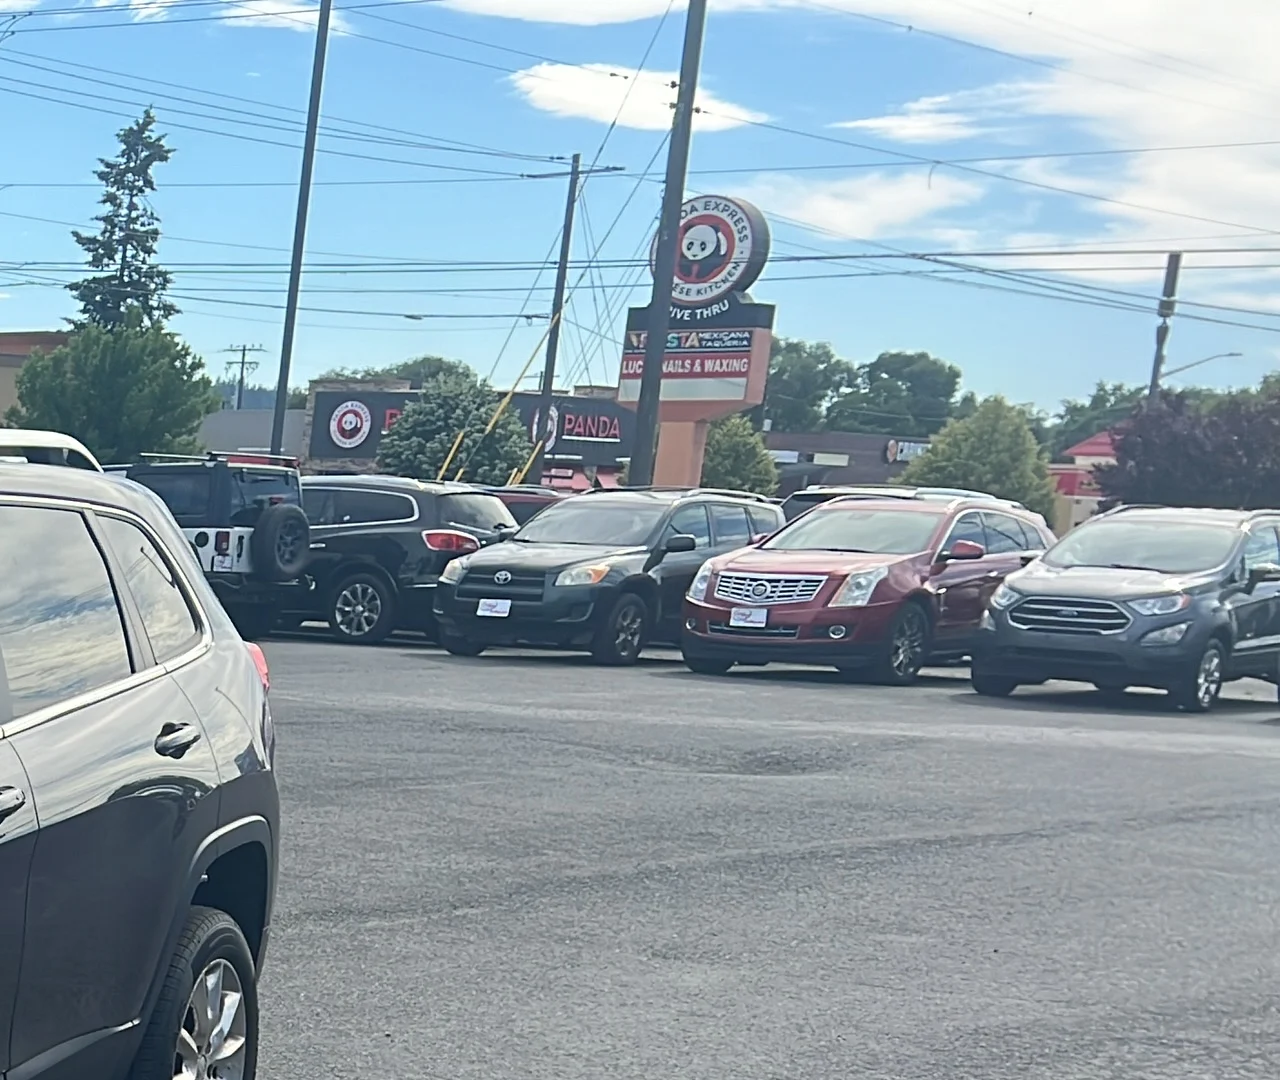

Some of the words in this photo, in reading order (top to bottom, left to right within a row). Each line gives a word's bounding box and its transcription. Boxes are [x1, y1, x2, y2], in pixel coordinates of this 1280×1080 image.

[703, 200, 749, 243] EXPRESS
[696, 261, 741, 296] KITCHEN
[670, 306, 692, 320] IVE
[695, 299, 729, 319] THRU
[698, 331, 750, 341] MEXICANA
[701, 339, 748, 347] TAQUERIA
[693, 359, 702, 373] &
[704, 358, 748, 373] WAXING
[564, 413, 620, 438] PANDA
